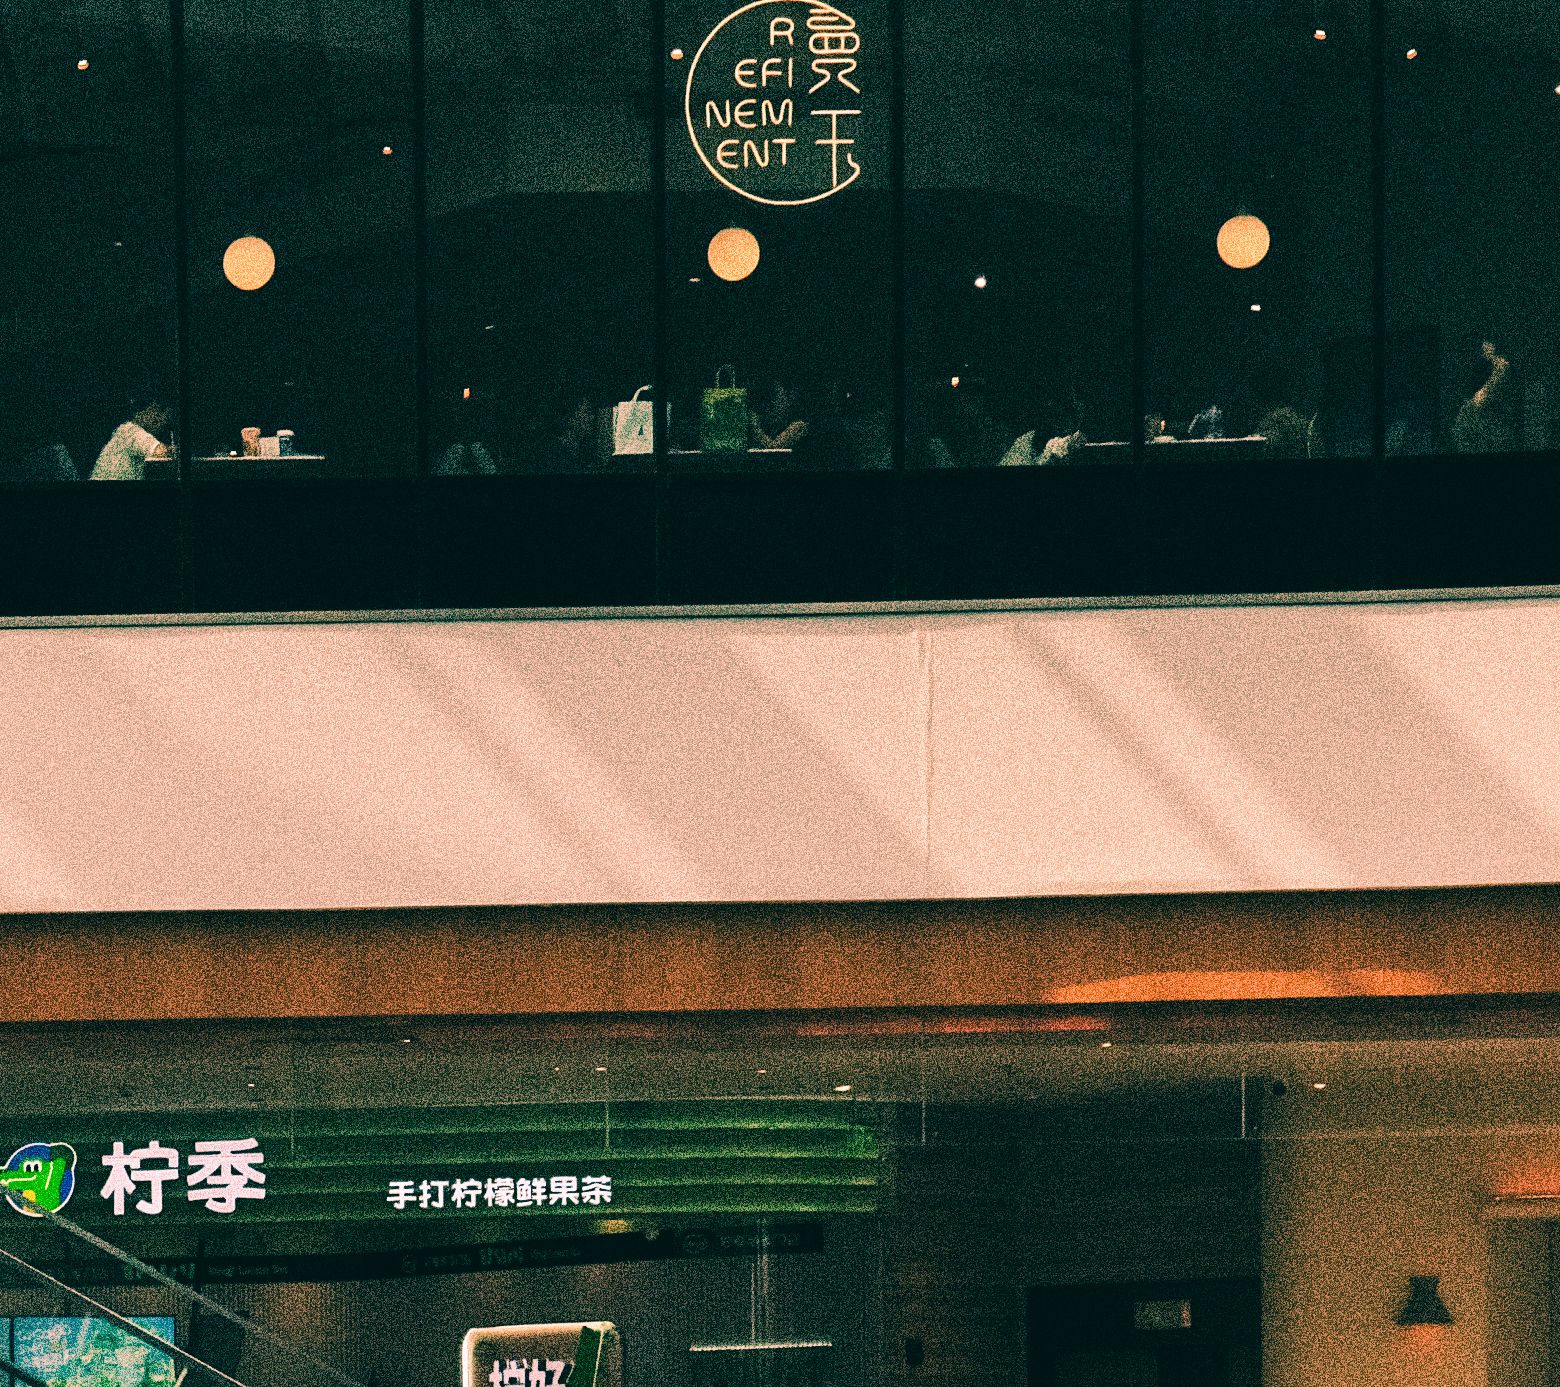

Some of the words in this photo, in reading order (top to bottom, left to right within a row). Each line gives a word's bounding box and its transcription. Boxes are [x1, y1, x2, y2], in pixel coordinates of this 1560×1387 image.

[769, 16, 795, 47] R
[734, 57, 794, 89] EFI
[705, 98, 794, 129] NEM
[716, 137, 796, 170] ENT
[99, 1136, 267, 1216] 柠季
[386, 1173, 614, 1211] 手打柠檬鲜果茶
